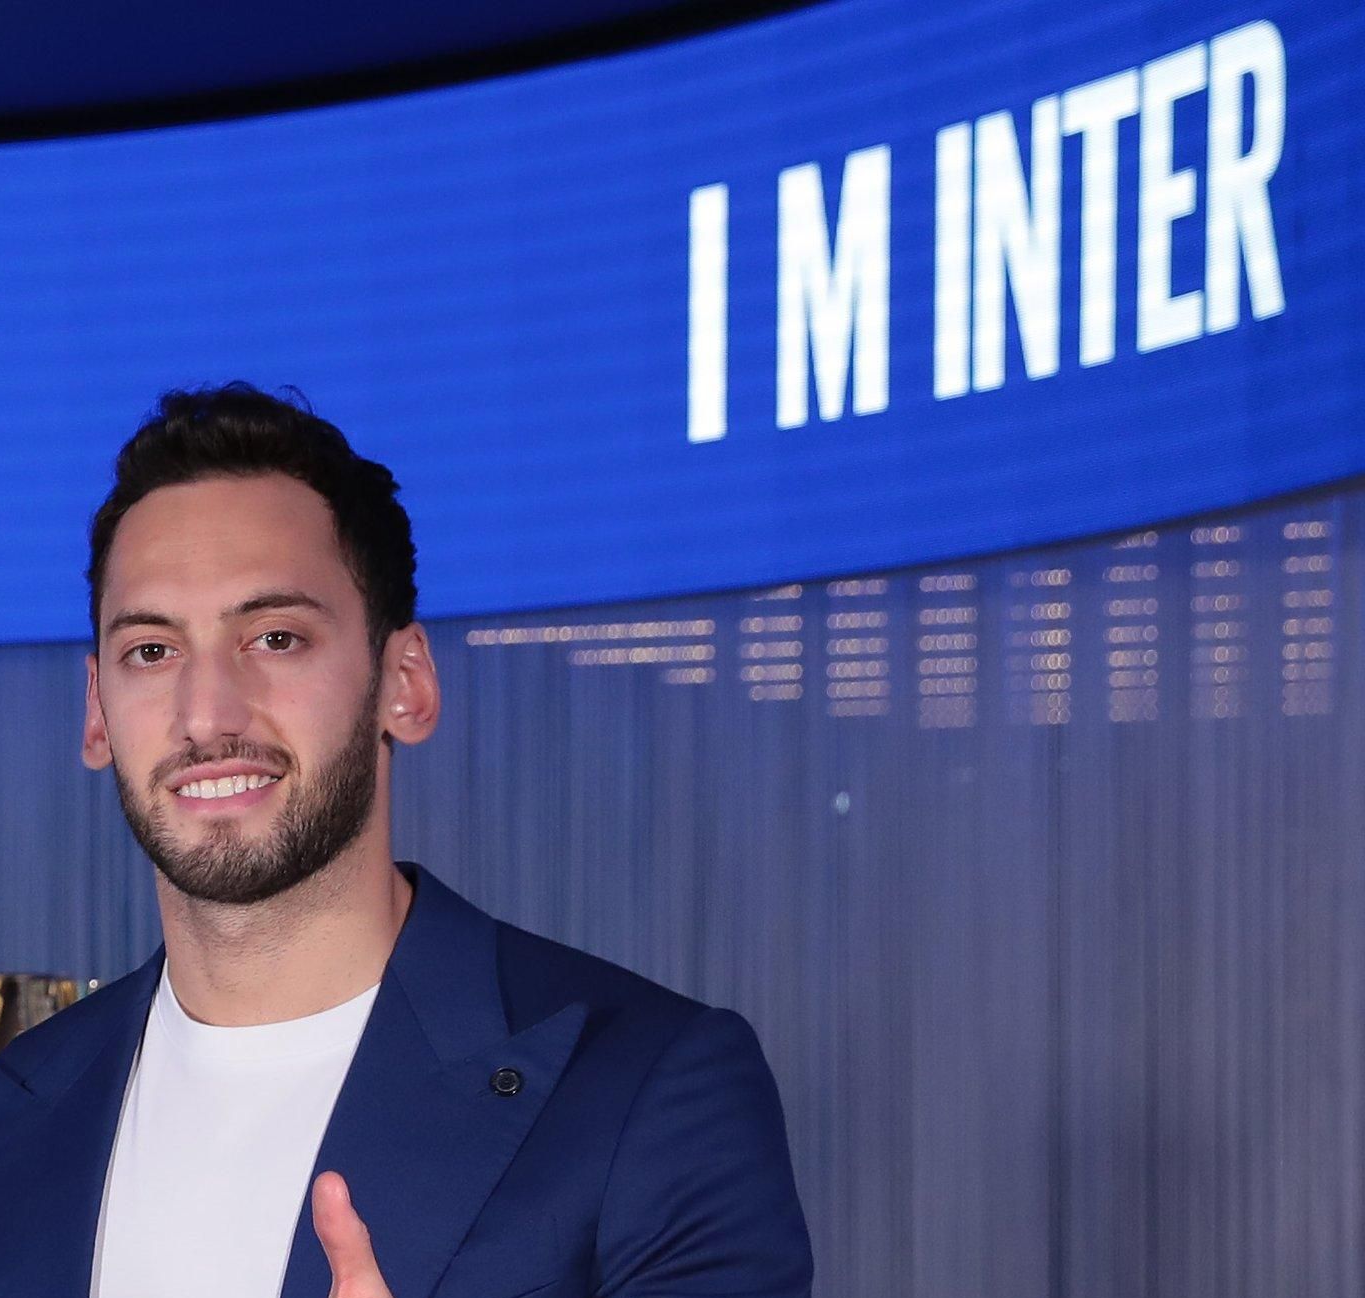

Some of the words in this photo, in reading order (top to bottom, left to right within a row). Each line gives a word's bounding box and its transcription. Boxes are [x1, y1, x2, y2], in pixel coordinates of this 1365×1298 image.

[687, 182, 729, 444] I
[776, 144, 892, 430] M
[933, 19, 1286, 401] INTER
